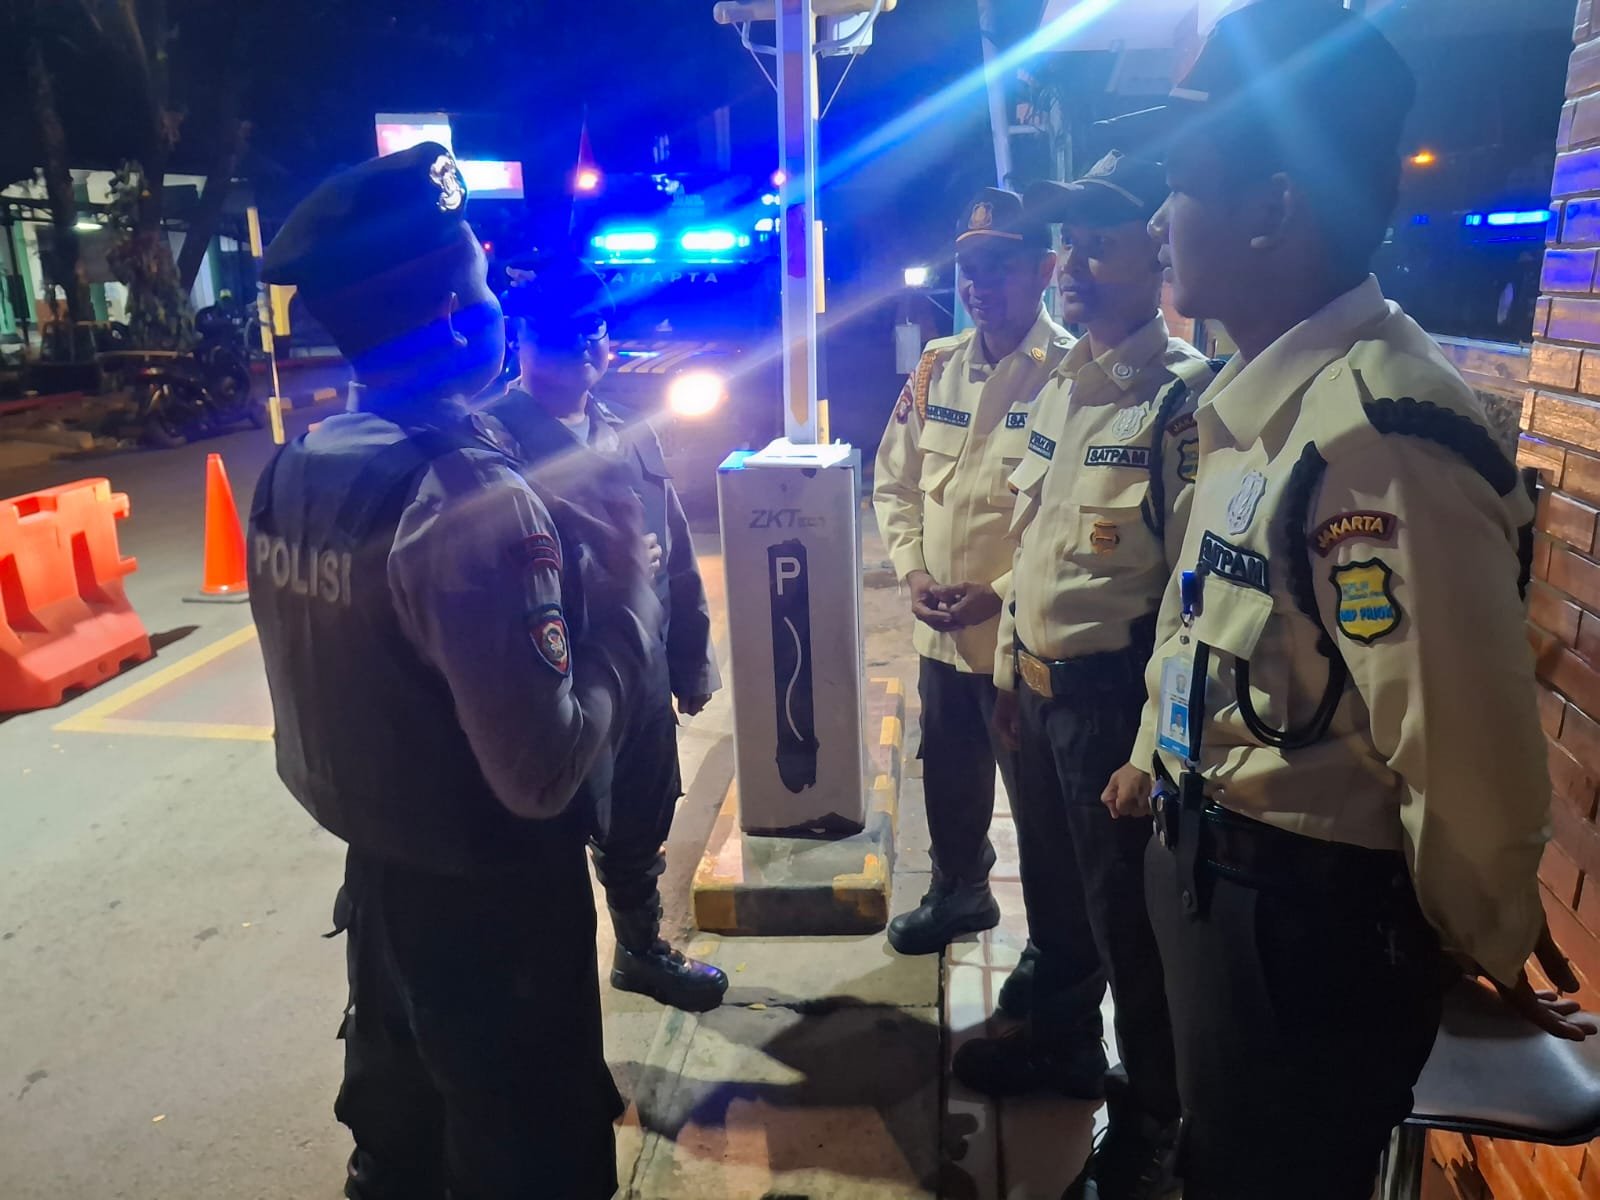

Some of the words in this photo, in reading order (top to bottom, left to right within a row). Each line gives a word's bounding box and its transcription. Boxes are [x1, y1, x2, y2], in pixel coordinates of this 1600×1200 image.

[1089, 449, 1147, 465] SATPAM
[1317, 515, 1384, 548] JAKARTA
[255, 533, 353, 607] POLISI
[775, 556, 801, 596] P
